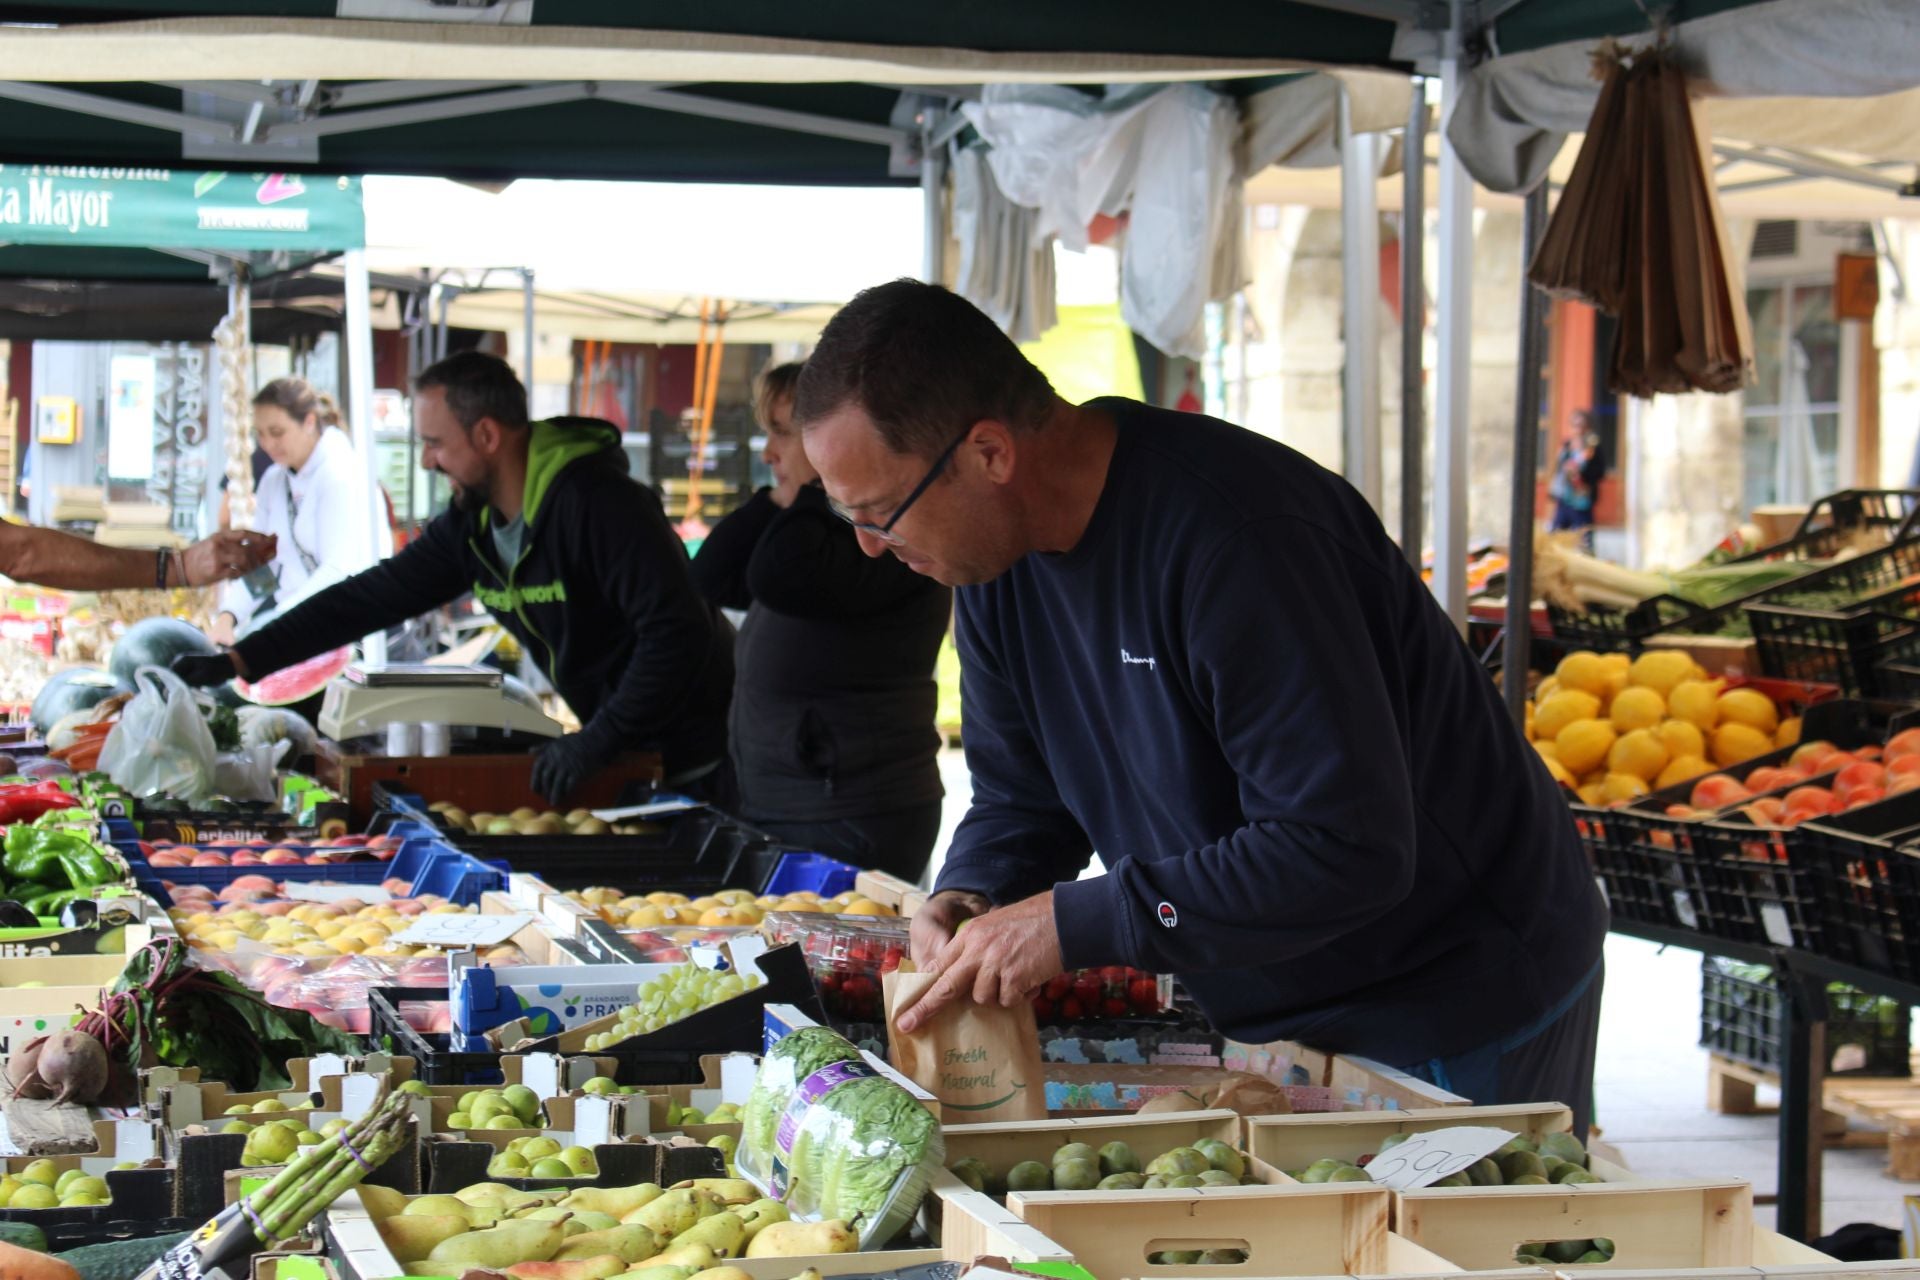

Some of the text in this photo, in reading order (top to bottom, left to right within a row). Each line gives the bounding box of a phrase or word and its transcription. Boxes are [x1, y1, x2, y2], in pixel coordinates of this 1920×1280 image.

[28, 177, 113, 233] Mayor
[944, 1046, 987, 1066] Fresh
[939, 1068, 996, 1090] Natural
